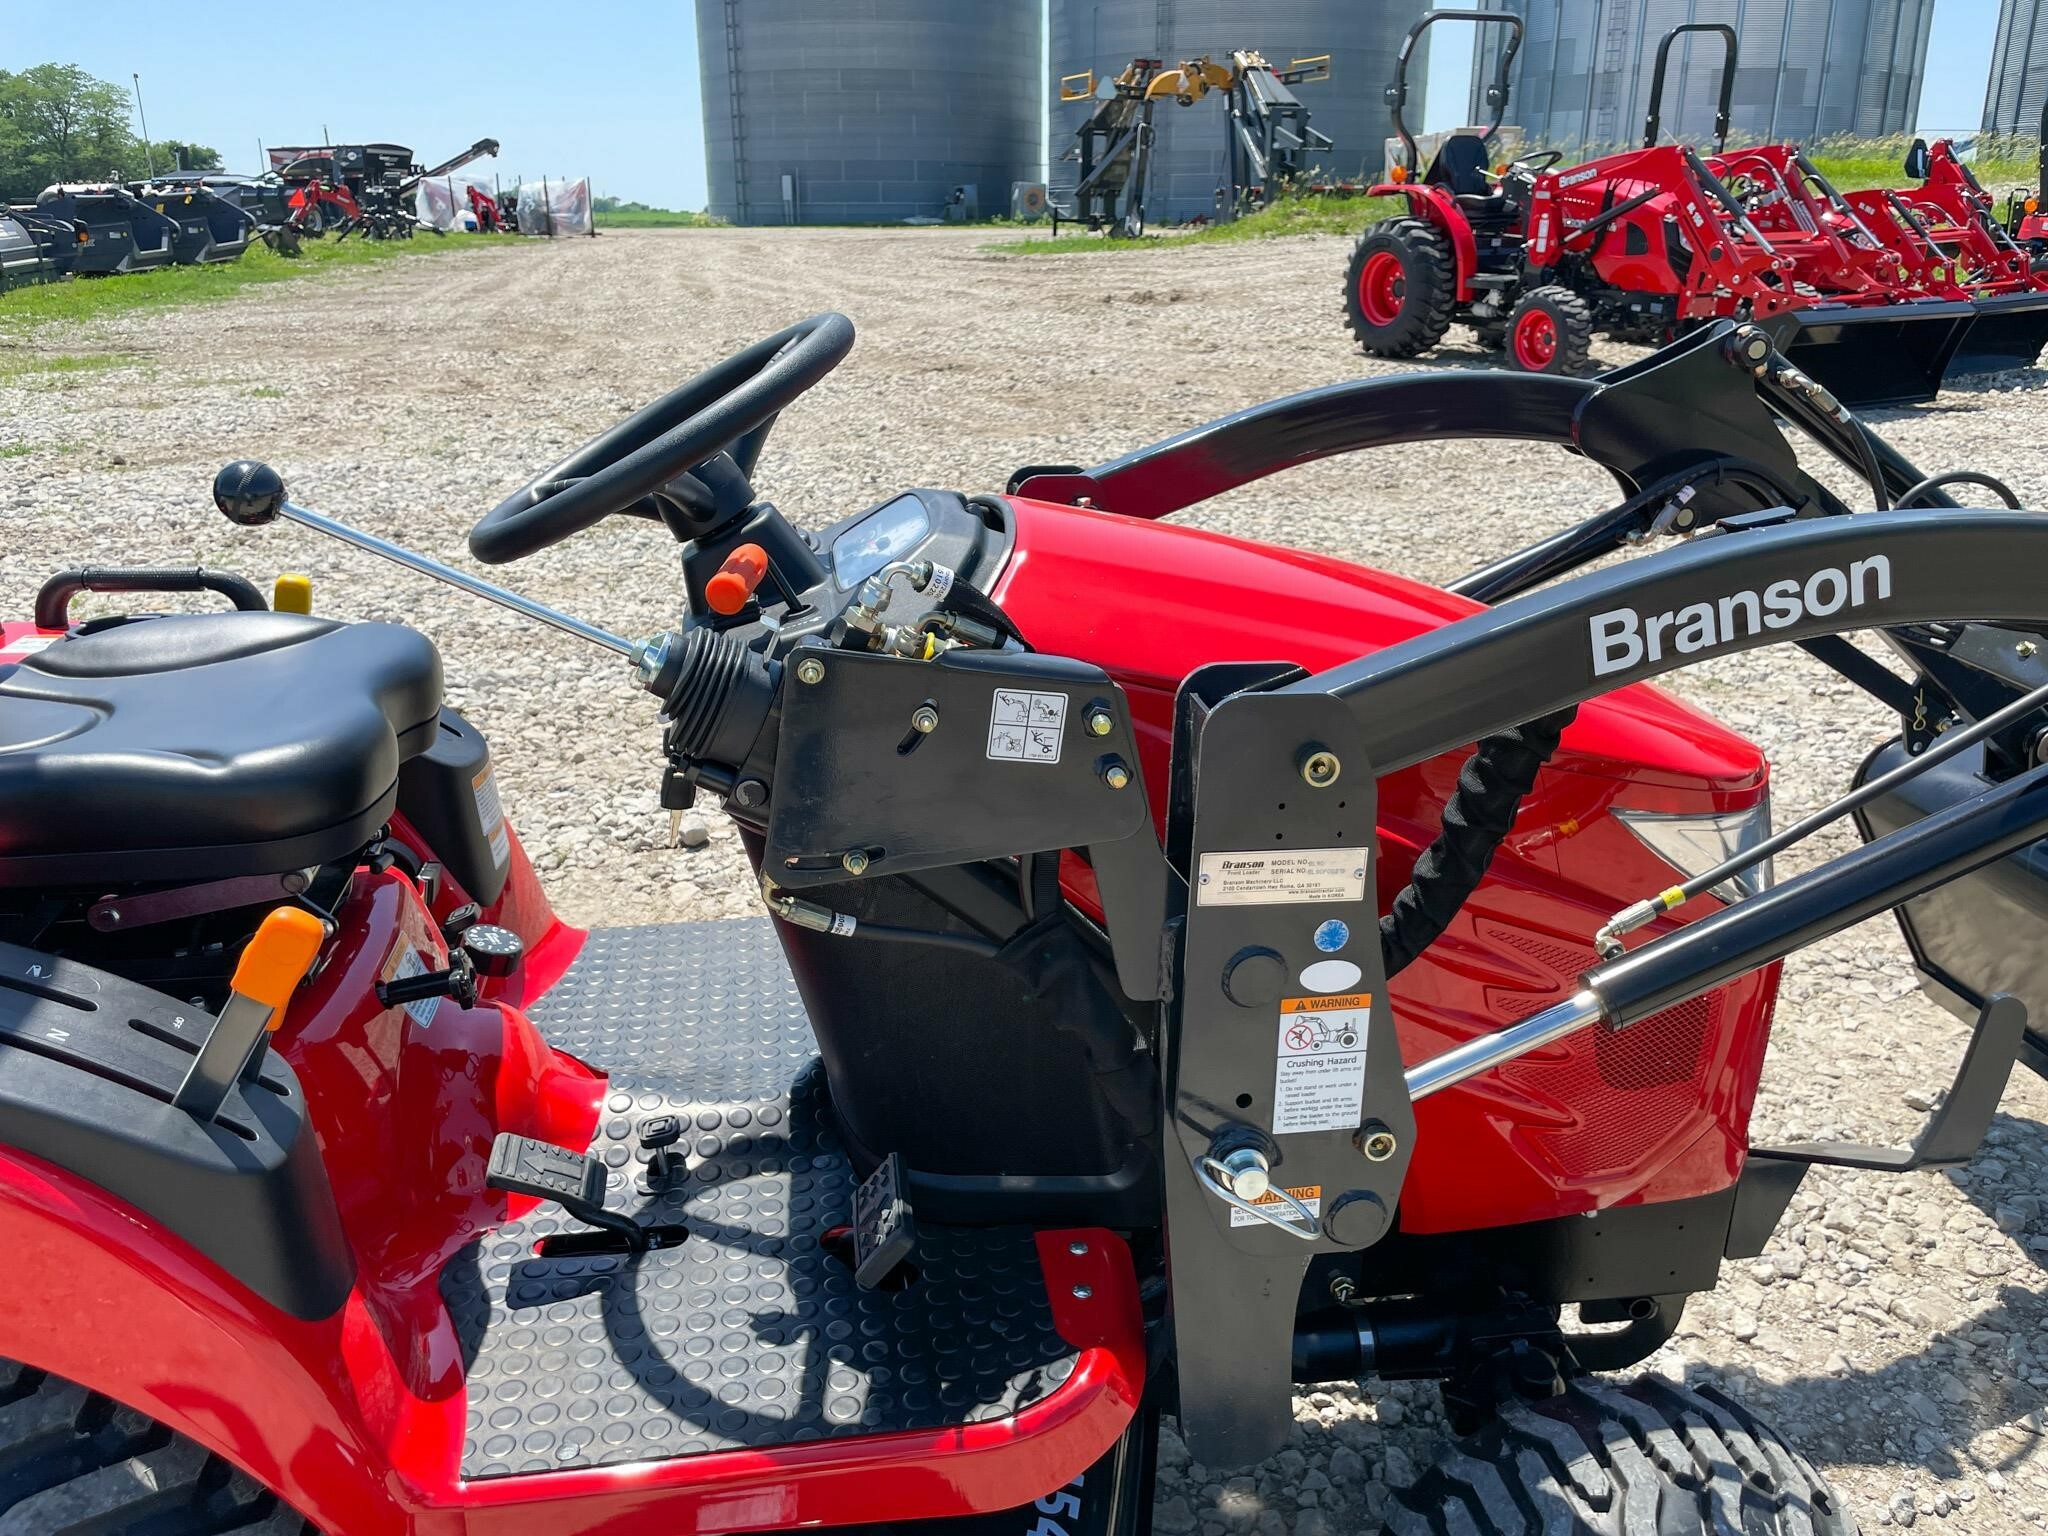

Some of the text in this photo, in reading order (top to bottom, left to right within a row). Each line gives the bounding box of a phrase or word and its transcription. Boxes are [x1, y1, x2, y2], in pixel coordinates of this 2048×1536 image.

[1559, 168, 1597, 188] Branson
[1589, 554, 1891, 677] Branson
[1222, 860, 1264, 869] Branson
[1310, 997, 1360, 1009] WARNING
[173, 1016, 185, 1030] OFF
[46, 1028, 71, 1042] N
[1286, 1056, 1357, 1068] Crushing Hazard
